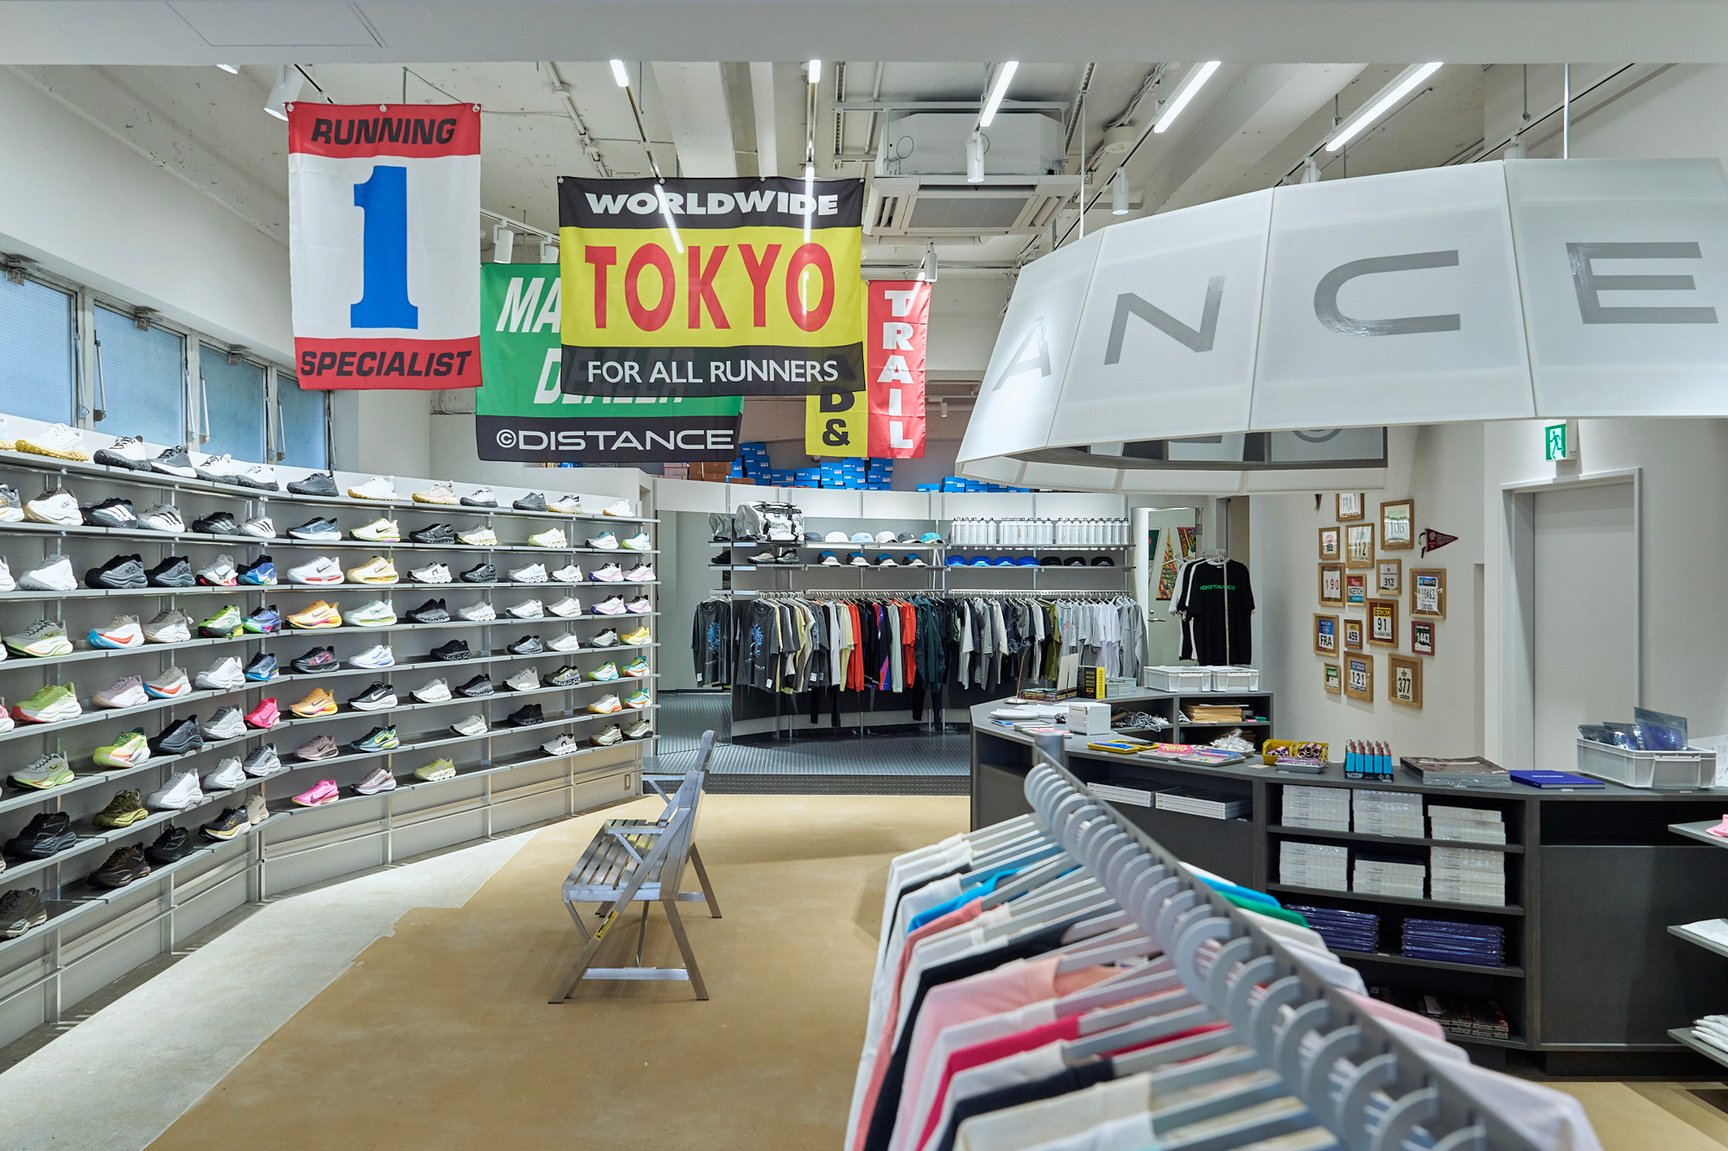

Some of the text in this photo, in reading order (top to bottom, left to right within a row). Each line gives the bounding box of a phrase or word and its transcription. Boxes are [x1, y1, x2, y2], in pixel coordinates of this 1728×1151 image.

[311, 118, 457, 145] RUNNING
[585, 190, 839, 215] WORLDWIDE
[350, 165, 419, 330] 1
[585, 242, 836, 332] TOKYO
[495, 277, 561, 333] MA
[300, 350, 473, 377] SPECIALIST
[588, 360, 839, 384] FOR ALL RUNNERS
[877, 290, 914, 449] TRAIL
[822, 419, 851, 447] &
[1325, 579, 1340, 591] 190
[1377, 617, 1387, 631] 91
[1320, 635, 1333, 648] FRA
[1351, 672, 1365, 686] 121
[1398, 678, 1411, 694] 377
